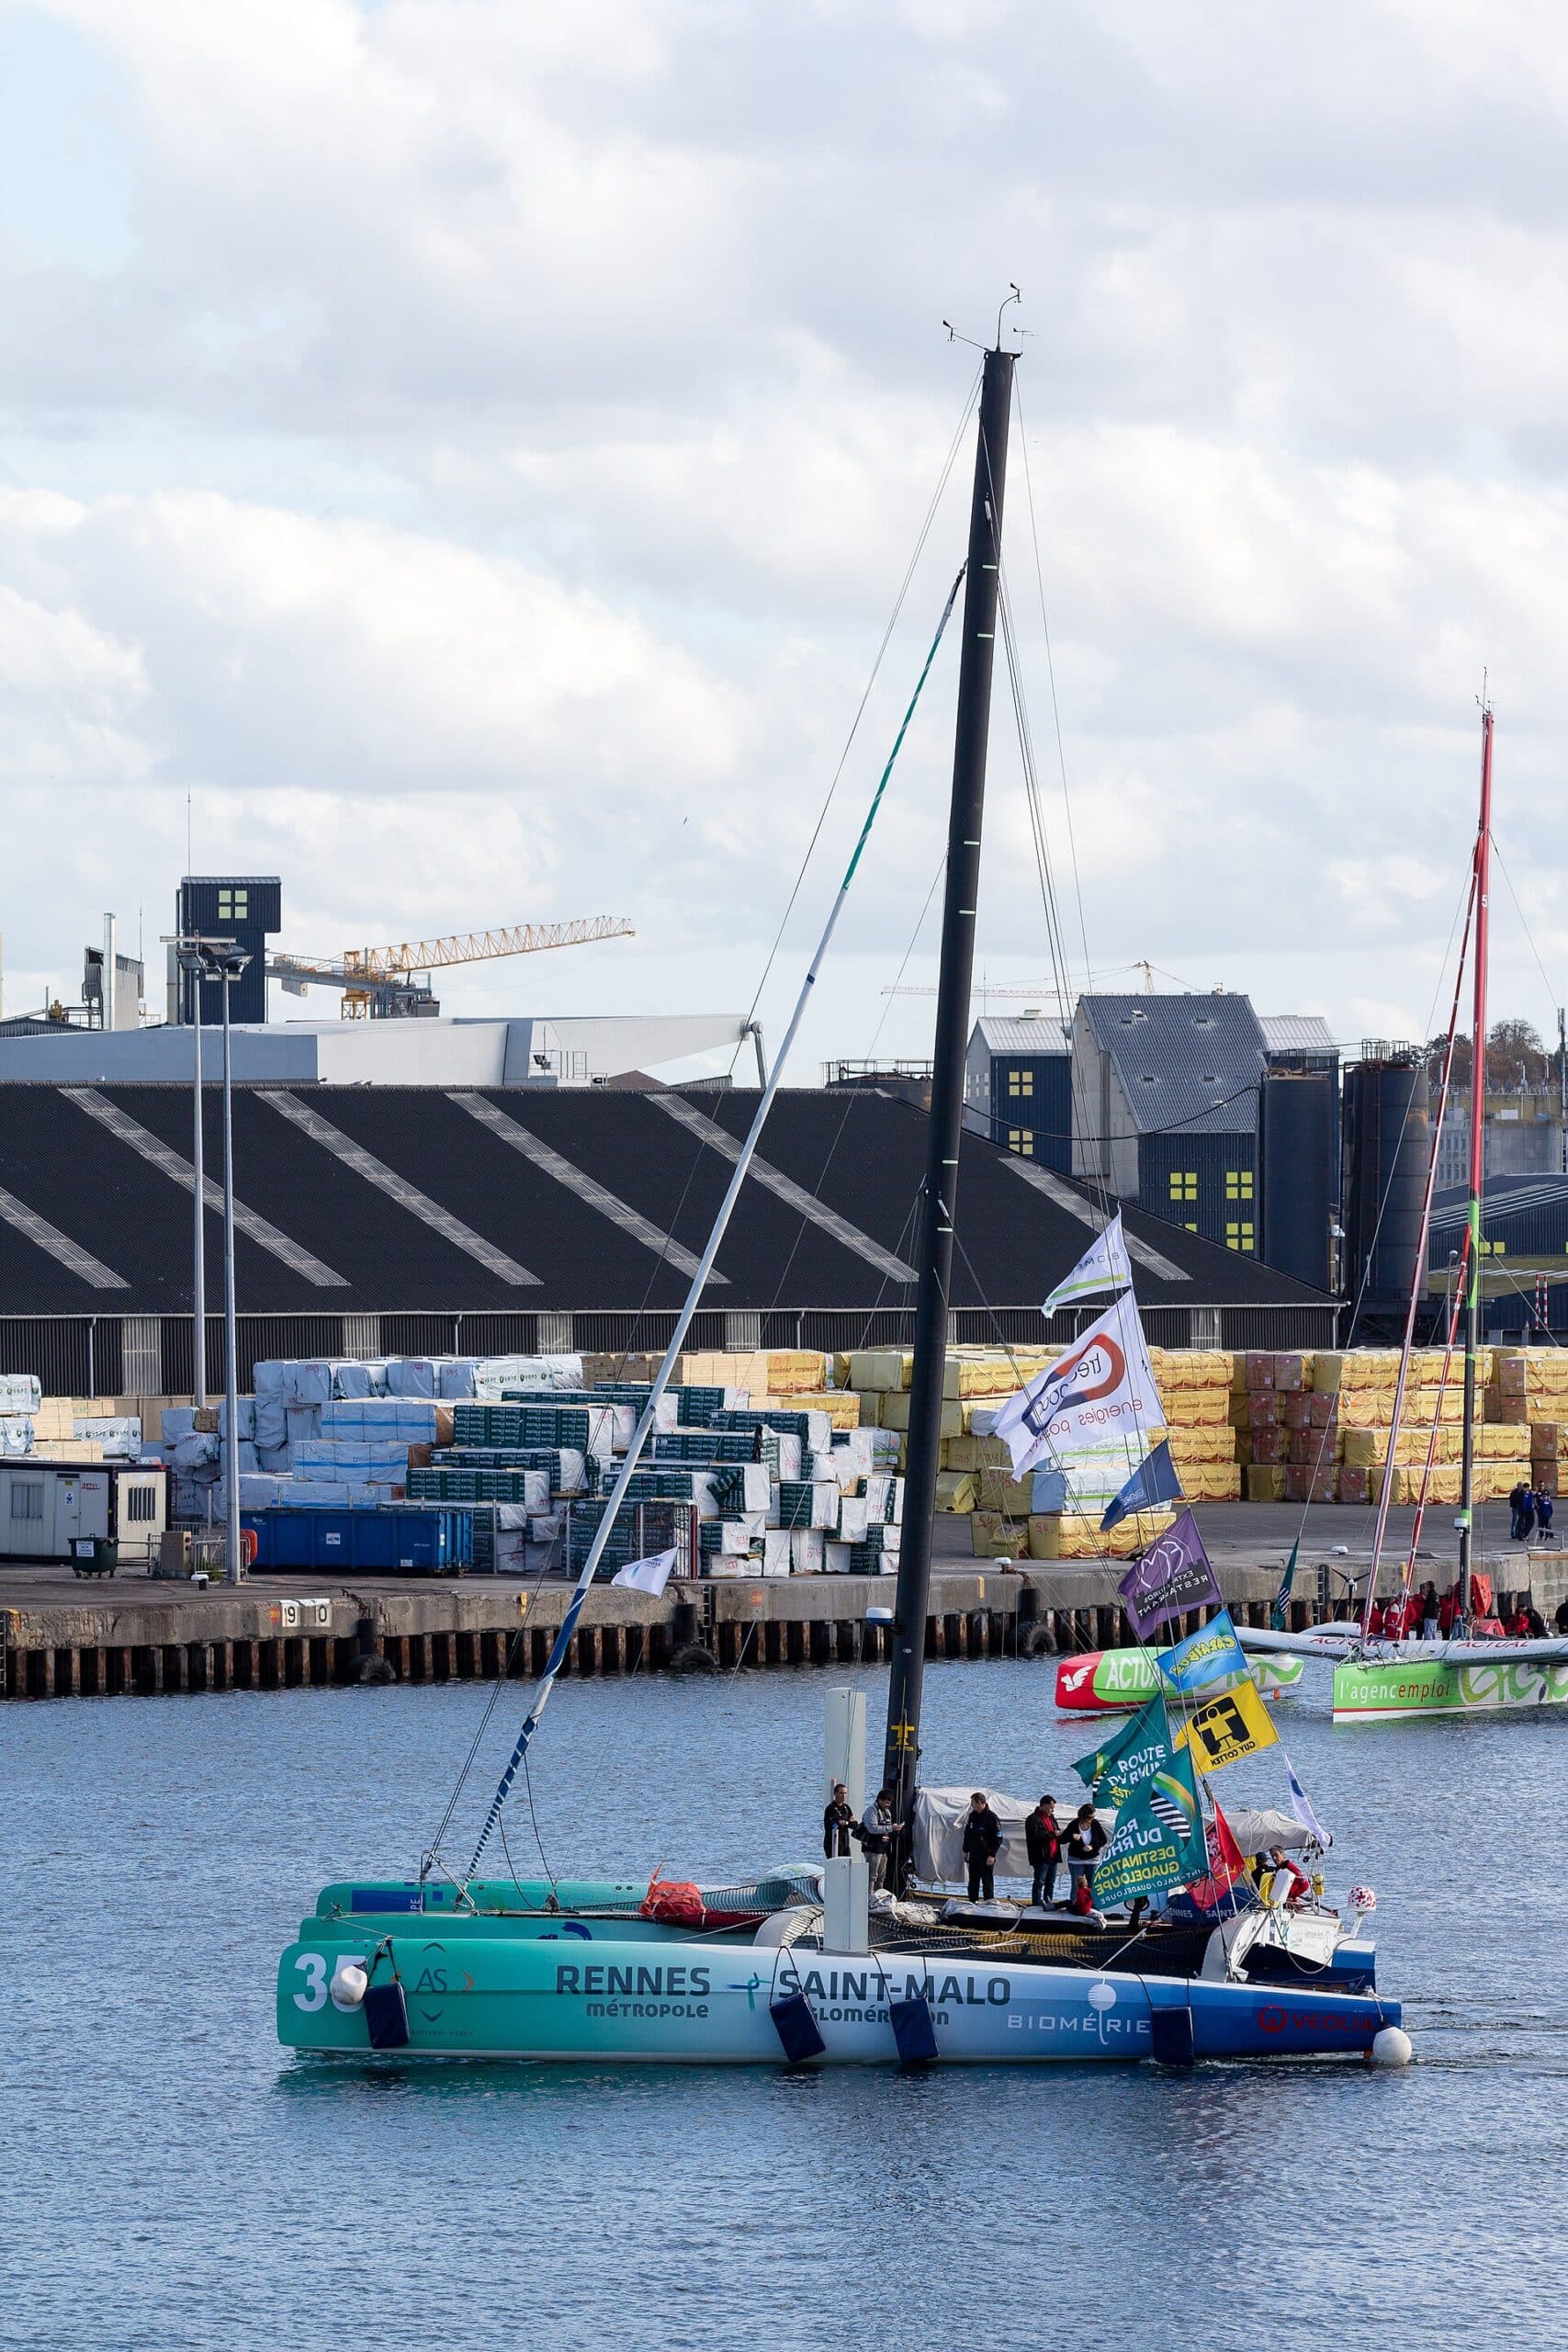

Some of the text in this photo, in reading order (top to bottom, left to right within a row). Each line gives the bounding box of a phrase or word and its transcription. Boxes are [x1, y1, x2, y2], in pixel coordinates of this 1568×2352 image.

[1118, 1745, 1166, 1773] ROUTE
[415, 1968, 448, 1994] AS
[557, 1965, 711, 1996] RENNES
[778, 1969, 1010, 2007] SAINT-MALO
[1292, 2014, 1374, 2031] VEOLIA
